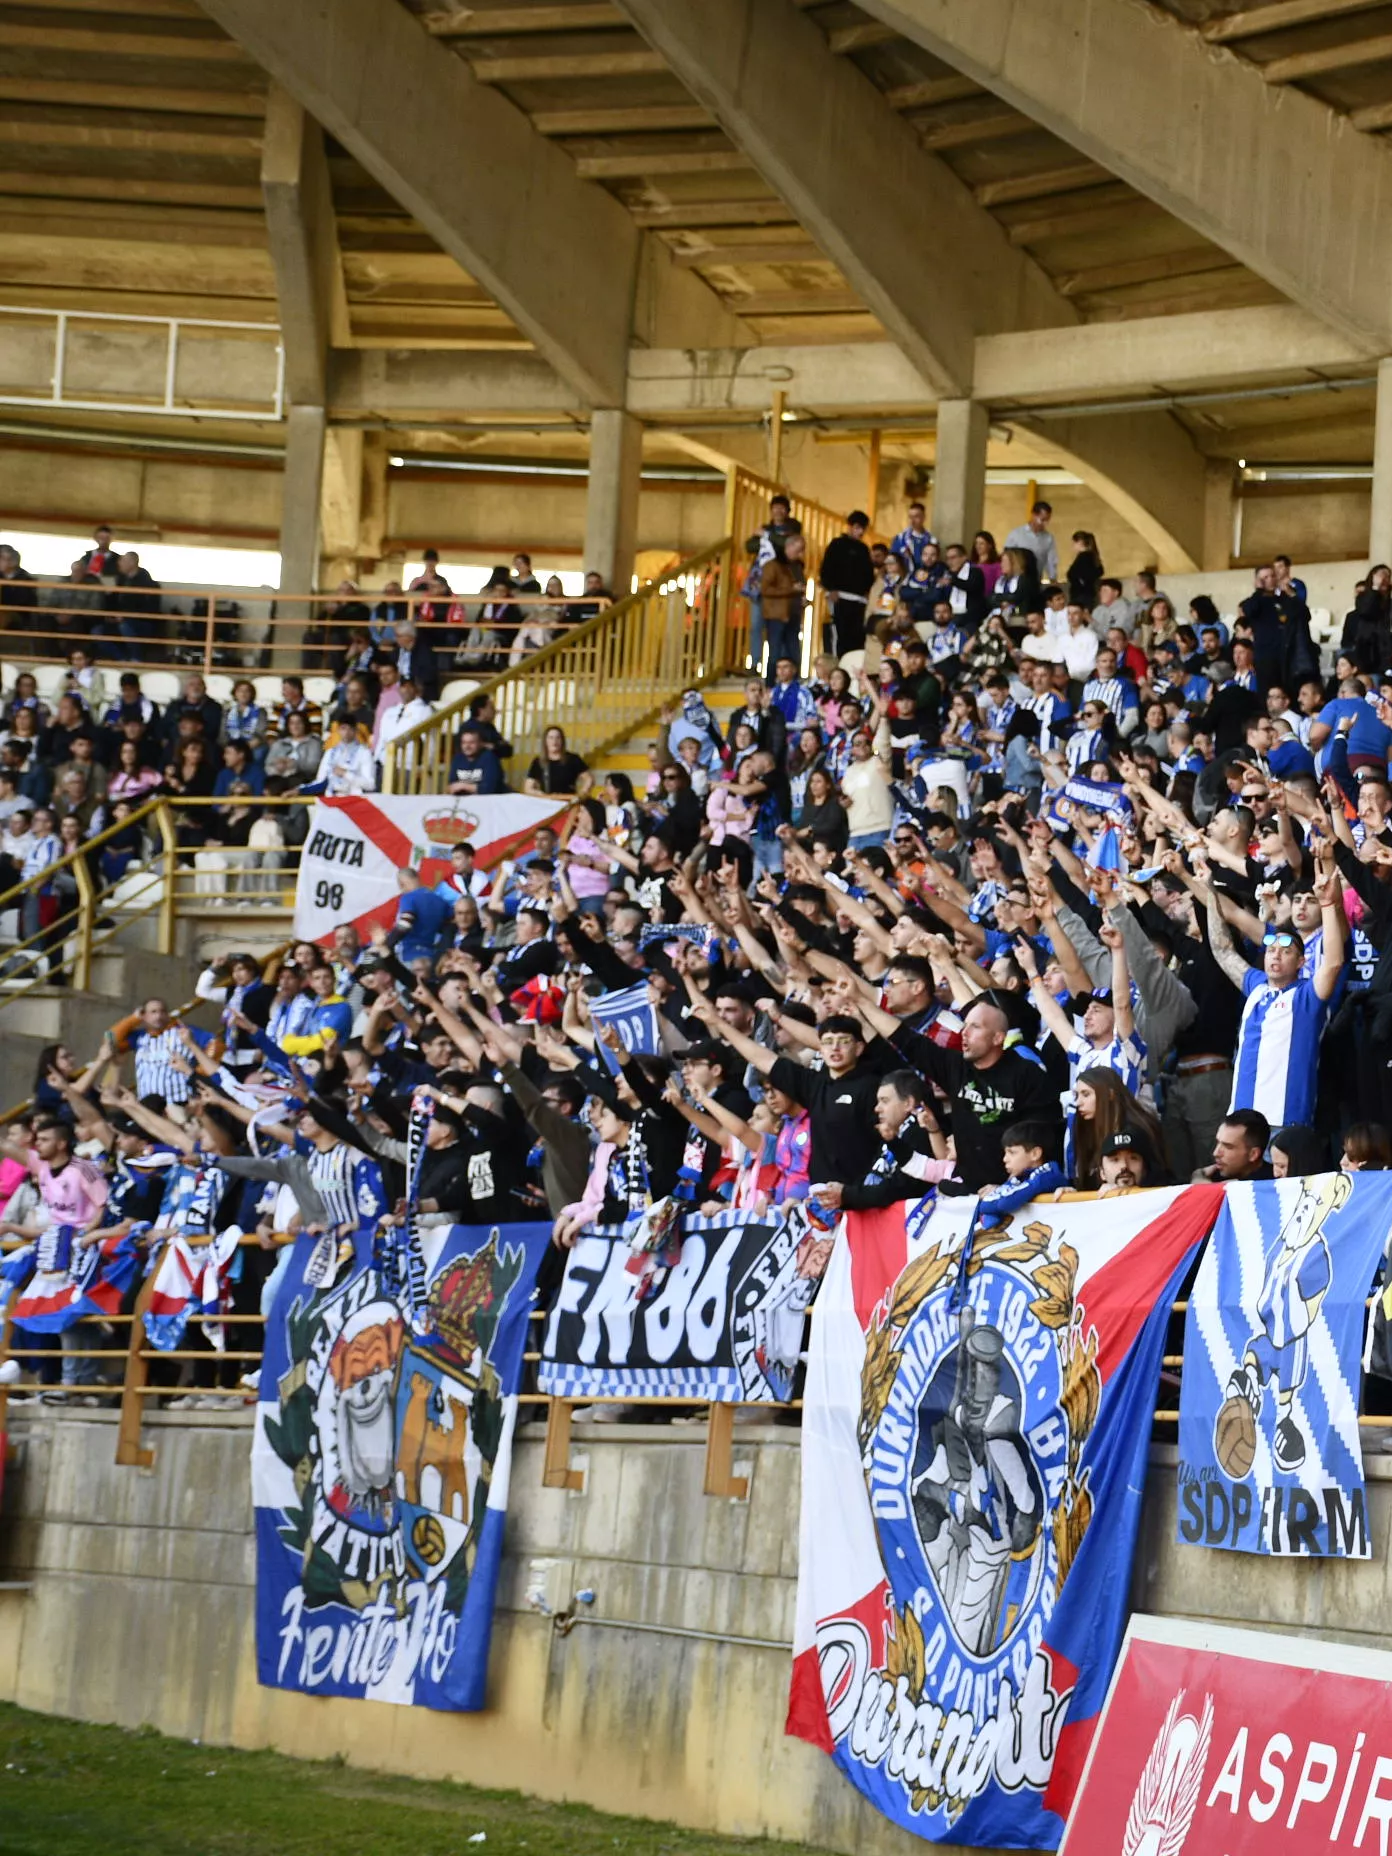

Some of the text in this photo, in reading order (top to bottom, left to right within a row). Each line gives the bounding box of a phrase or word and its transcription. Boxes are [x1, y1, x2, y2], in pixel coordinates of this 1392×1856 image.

[308, 829, 366, 868] RUTA
[868, 1272, 1051, 1520] DURANDATE 1922
[1180, 1481, 1252, 1548] SDP
